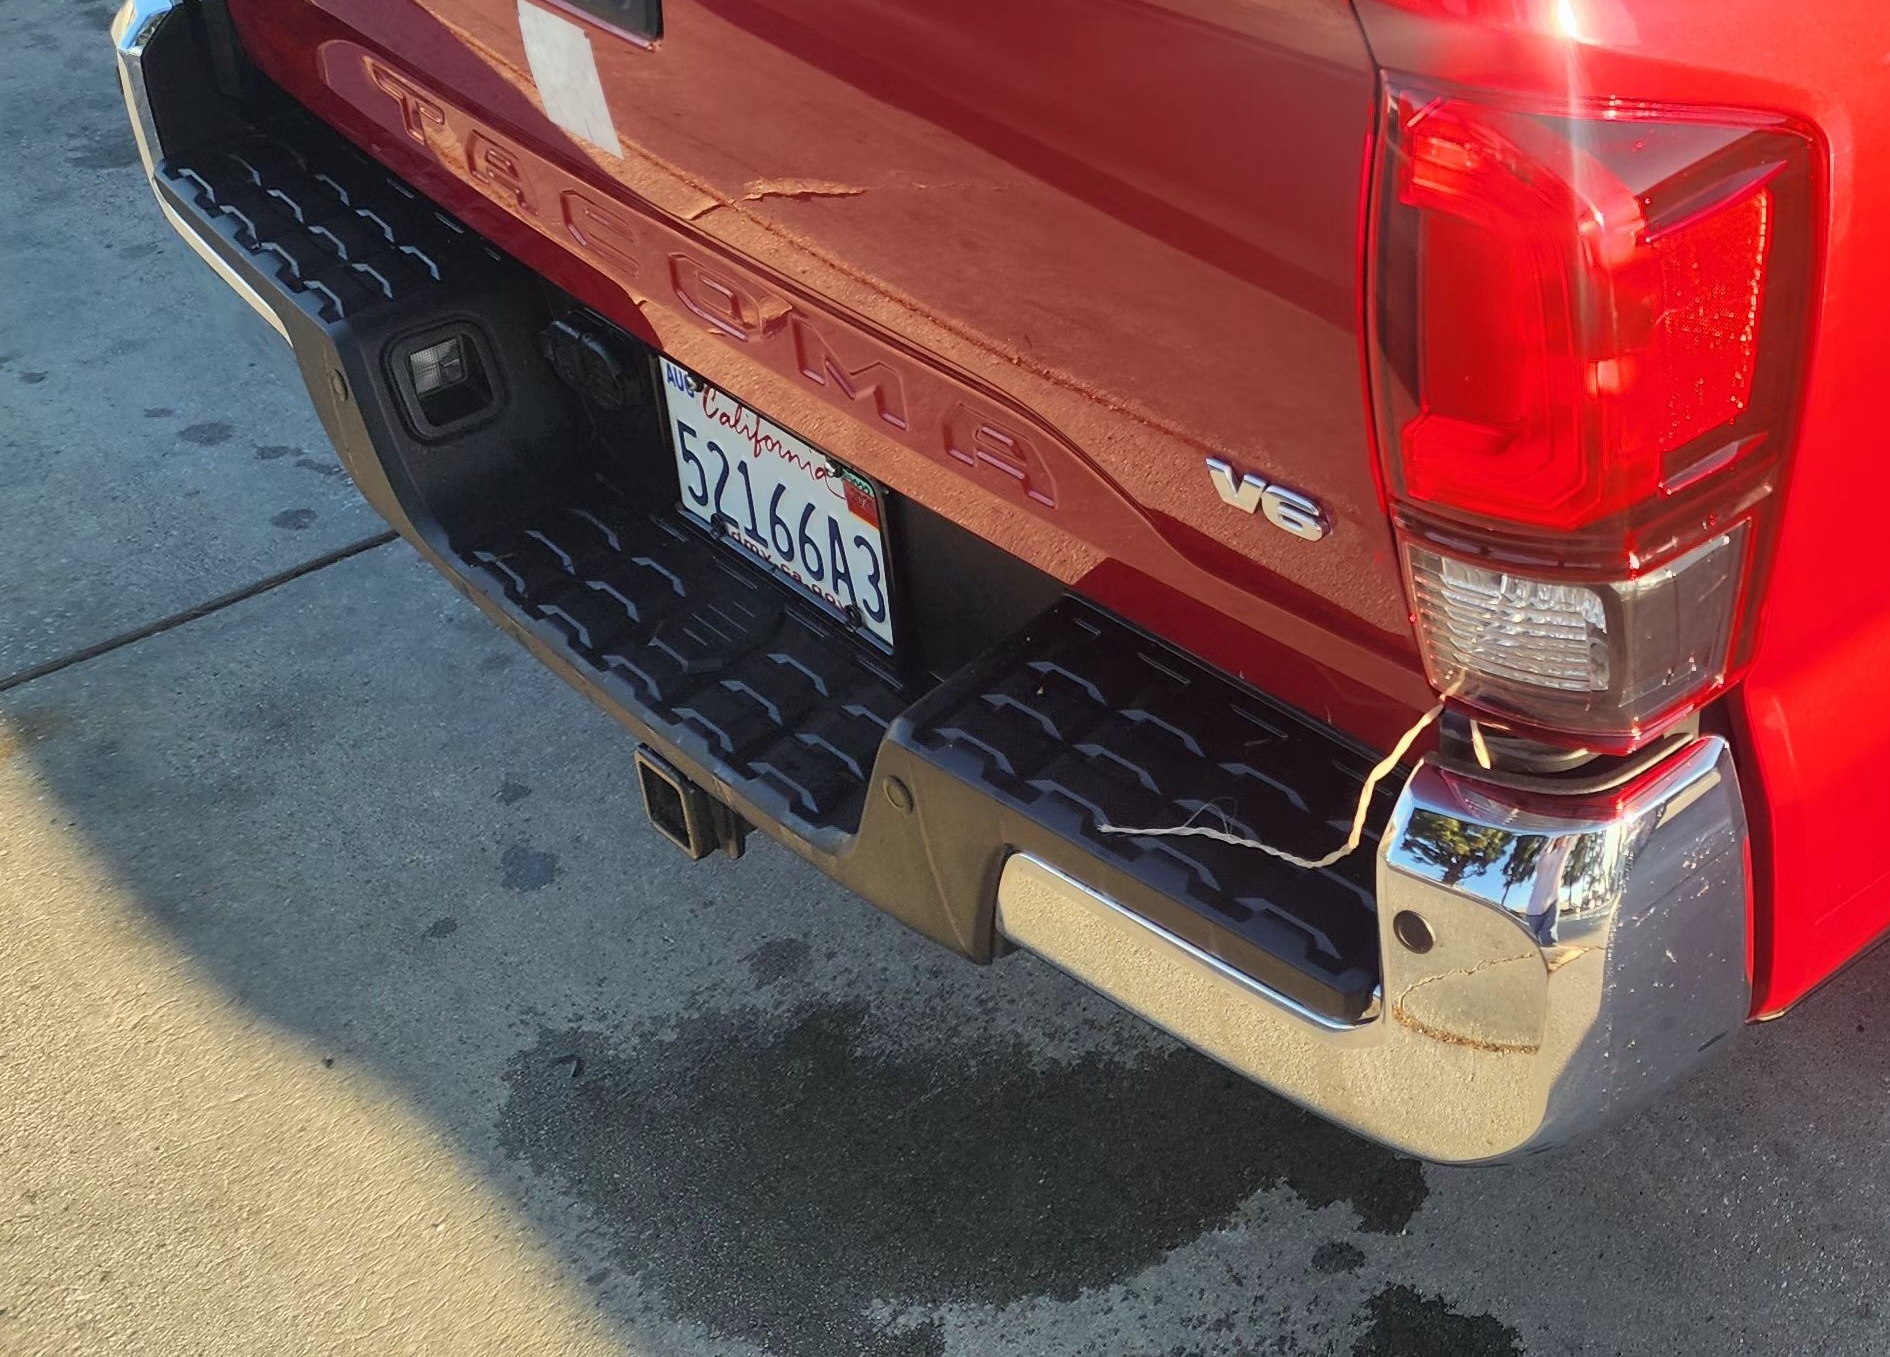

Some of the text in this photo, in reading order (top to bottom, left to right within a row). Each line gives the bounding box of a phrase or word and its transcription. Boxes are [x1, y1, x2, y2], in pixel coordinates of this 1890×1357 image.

[363, 54, 1059, 509] TACOMA
[702, 384, 832, 485] California
[1205, 456, 1331, 542] V6
[676, 419, 887, 624] 52166A3
